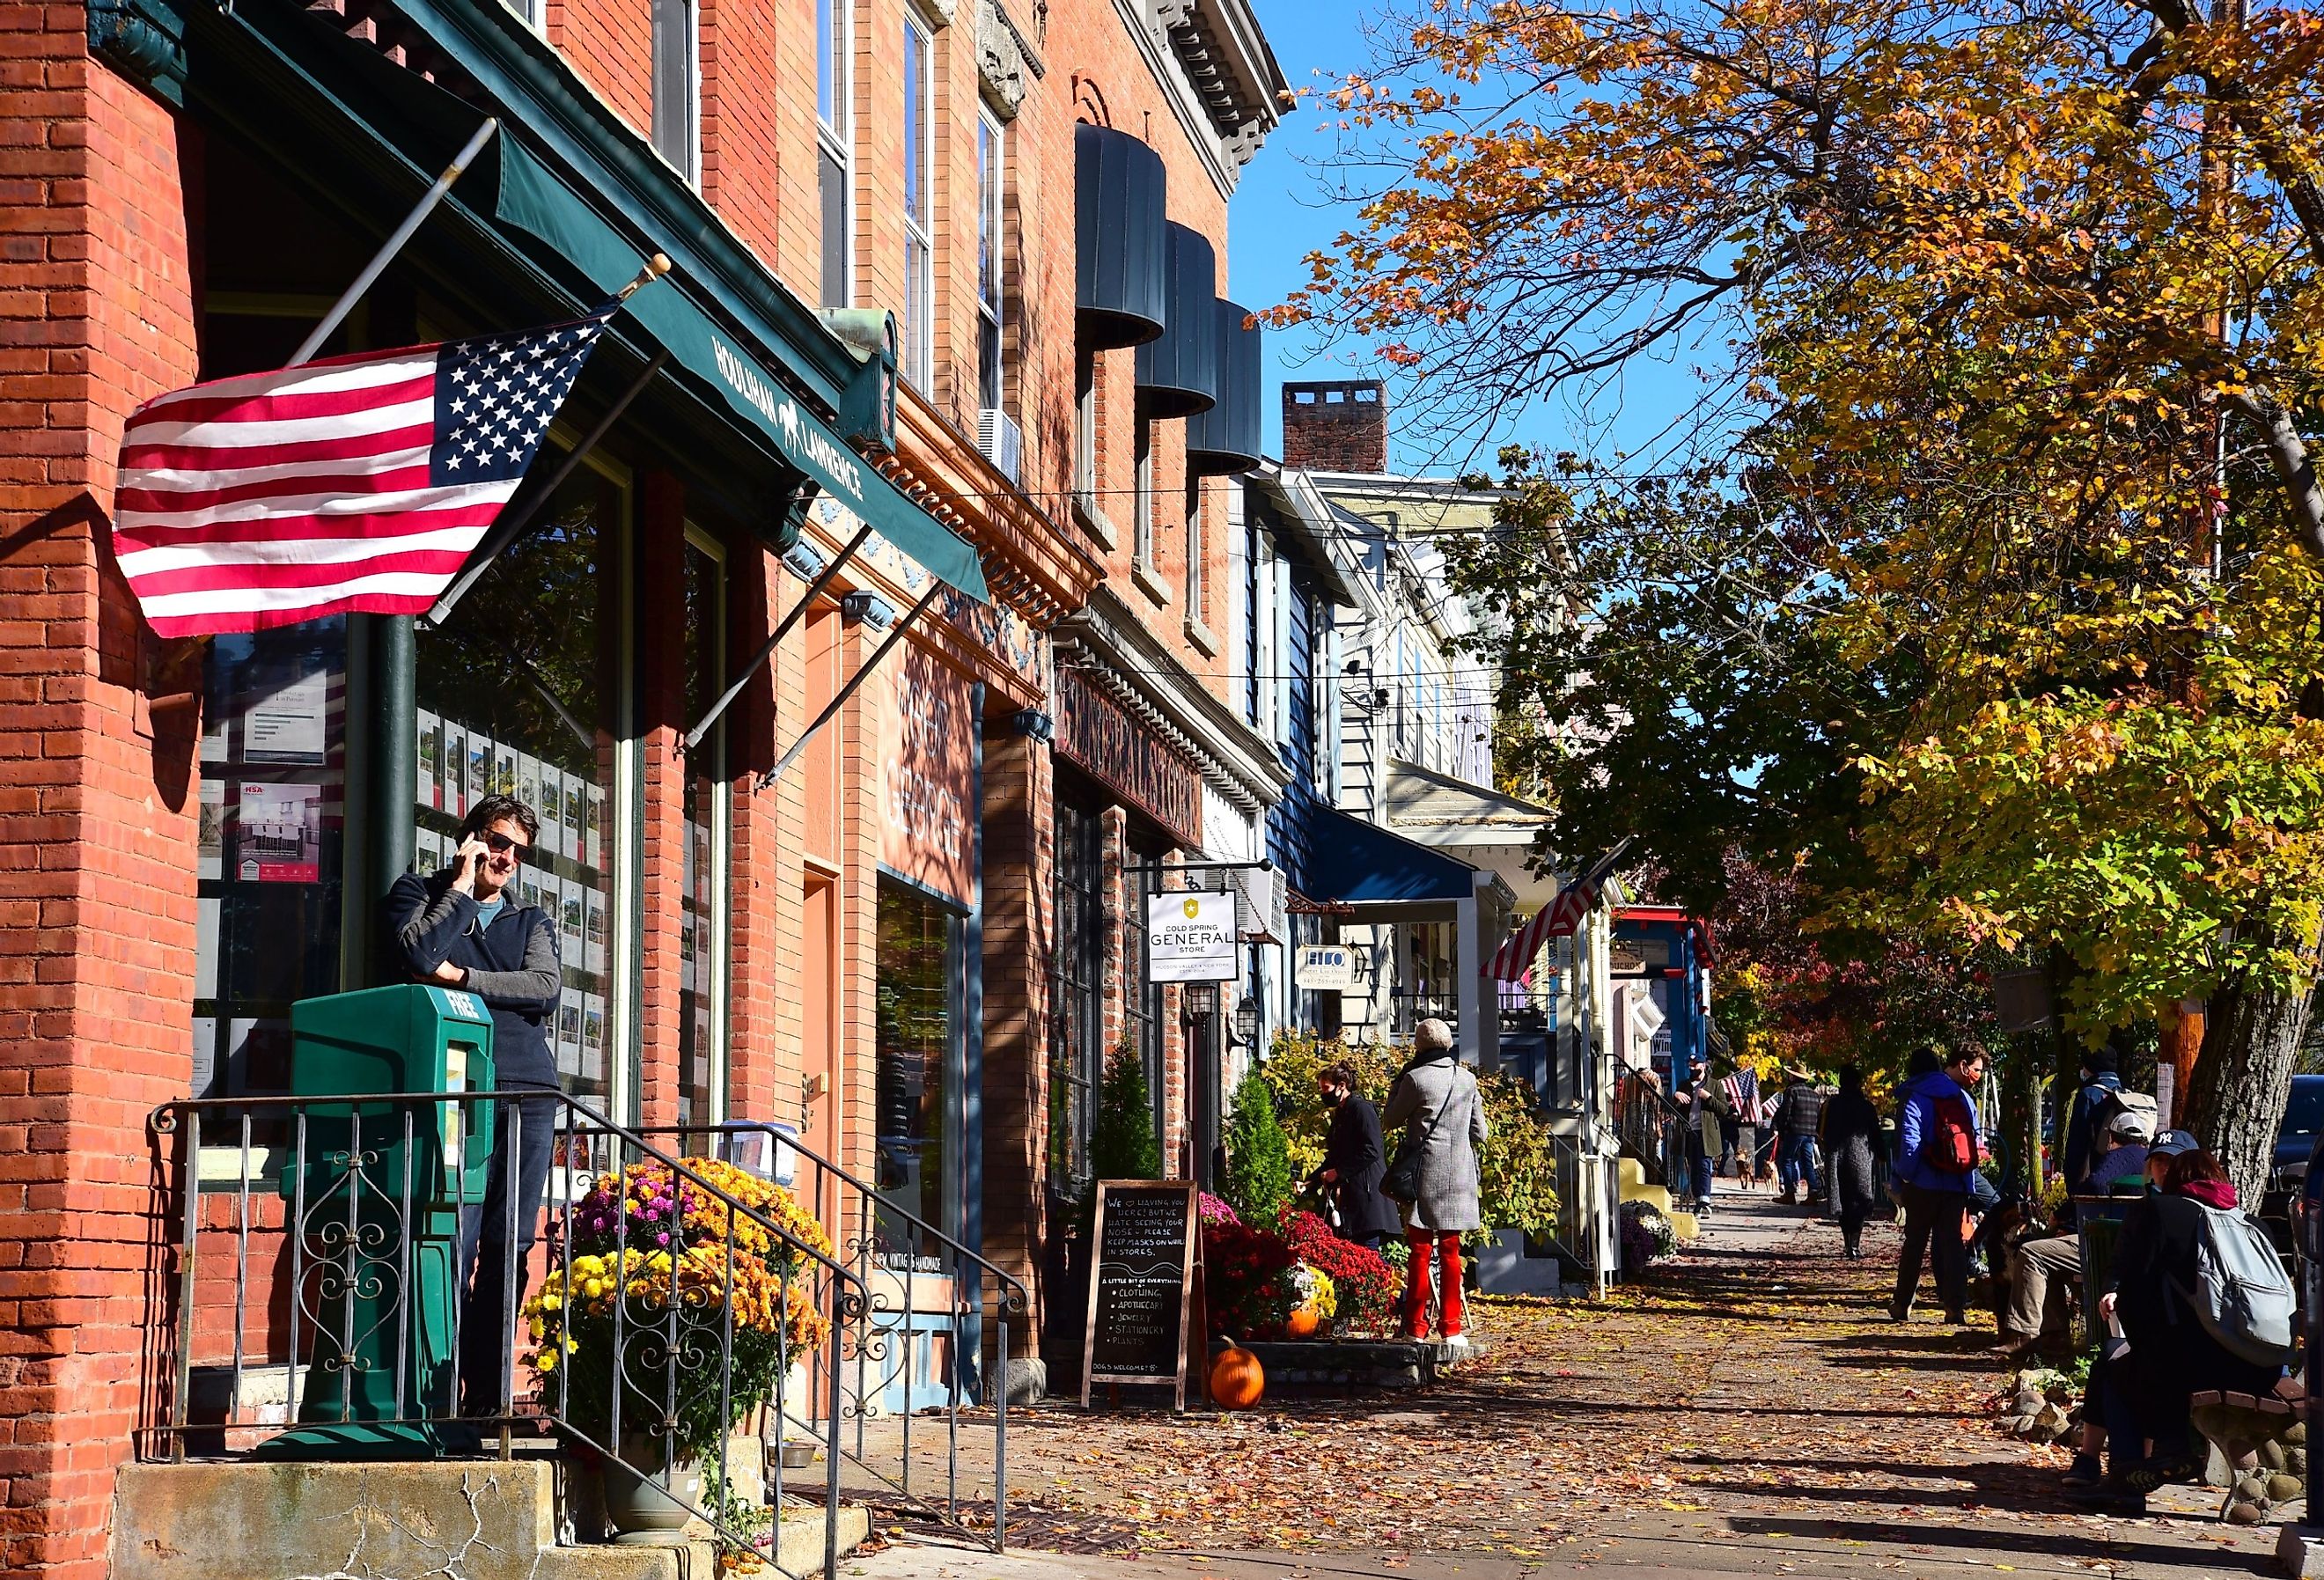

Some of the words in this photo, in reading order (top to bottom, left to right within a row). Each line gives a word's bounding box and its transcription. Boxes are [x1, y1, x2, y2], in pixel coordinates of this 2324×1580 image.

[711, 335, 778, 428] HOULIHAN
[801, 420, 864, 502] LAWRENCE
[886, 758, 960, 860] GEORGE
[1151, 932, 1234, 946] GENERAL
[1609, 961, 1641, 970] OUCHON
[445, 990, 480, 1019] FREE
[2158, 1132, 2173, 1143] NY
[1107, 1197, 1122, 1208] WE
[1165, 1218, 1184, 1227] YOUR
[890, 1252, 908, 1269] VINTAG
[916, 1254, 941, 1272] HANDMADE
[1117, 1312, 1151, 1323] JEWELRY
[1114, 1325, 1165, 1334] STATIONERY
